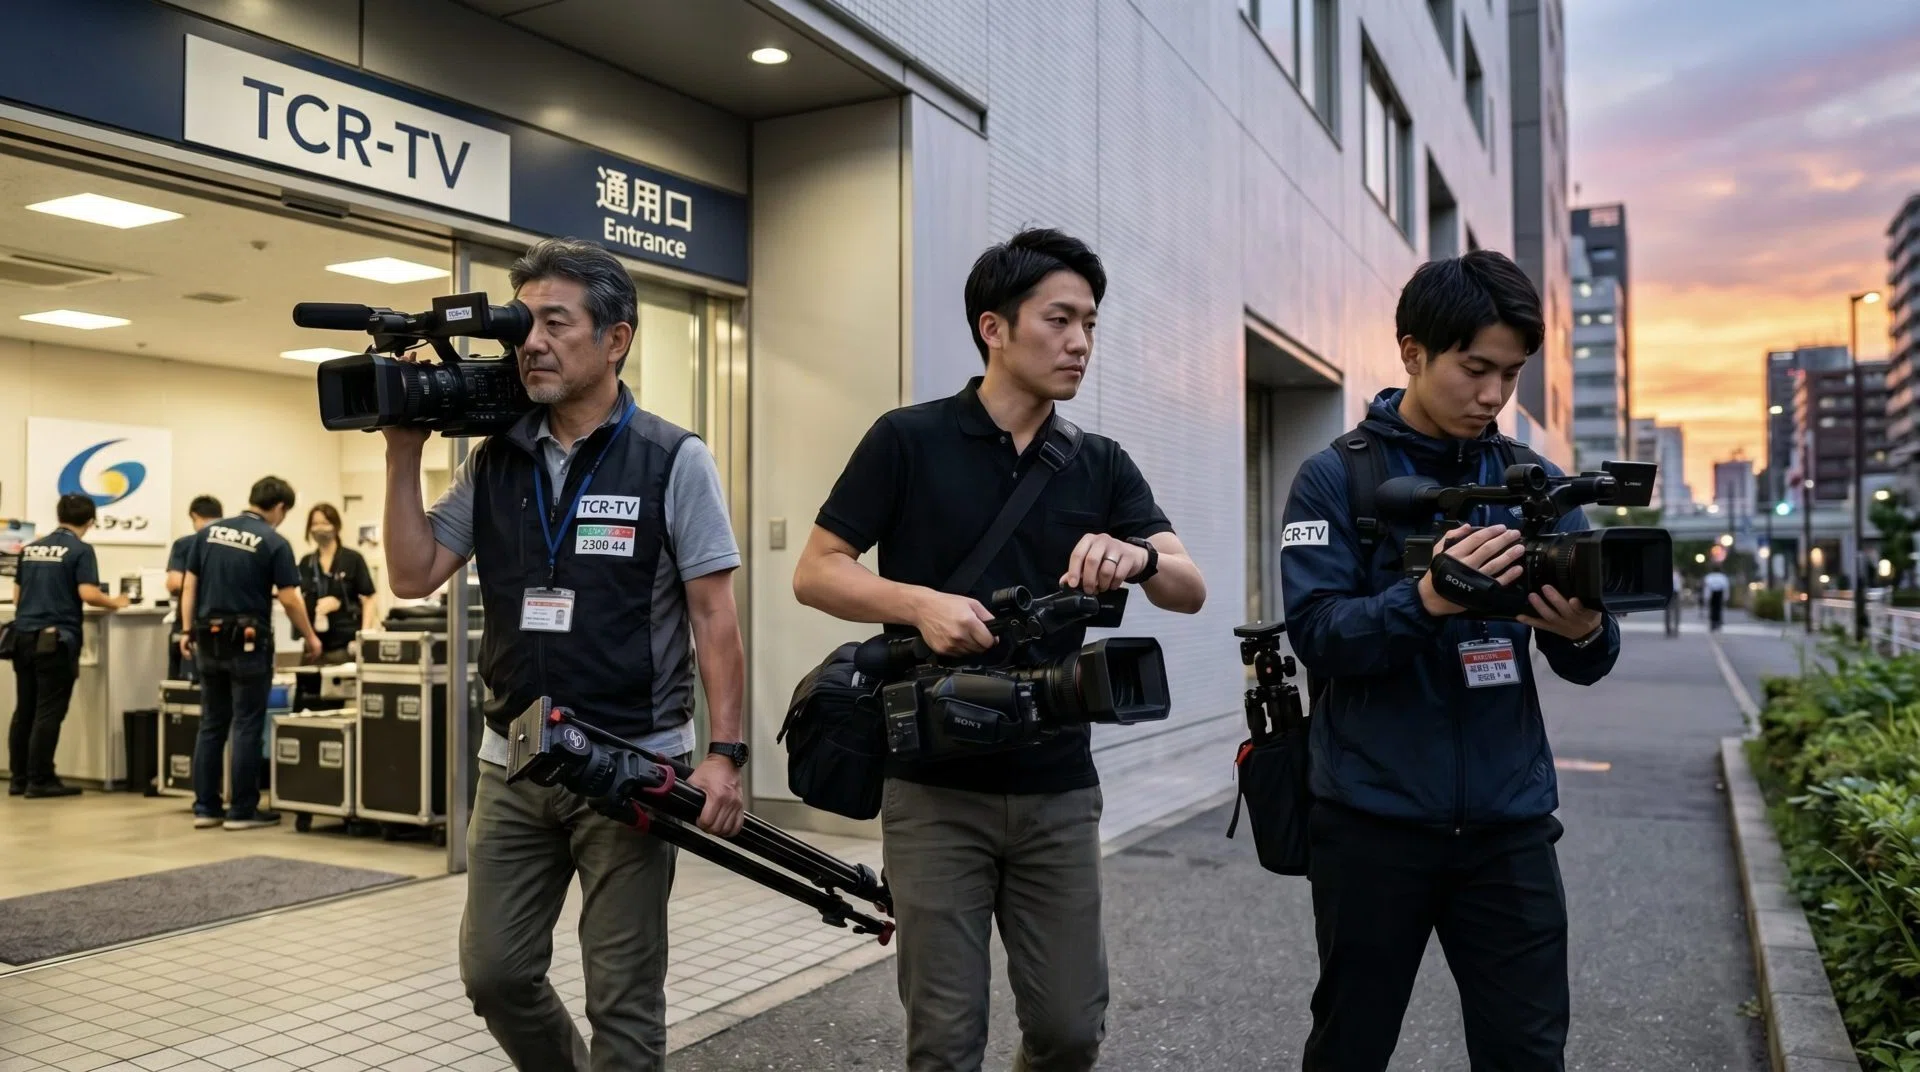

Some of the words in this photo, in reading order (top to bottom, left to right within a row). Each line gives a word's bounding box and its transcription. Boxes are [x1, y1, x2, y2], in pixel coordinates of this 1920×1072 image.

[243, 76, 471, 189] TCR-TV
[596, 165, 692, 232] 通用口
[604, 217, 687, 259] Entrance
[580, 500, 637, 515] TCR-TV
[95, 514, 149, 531] ション
[209, 525, 263, 547] TCR-TV
[1283, 526, 1326, 541] CR-TV
[611, 541, 626, 552] 44
[1445, 574, 1474, 592] SONY
